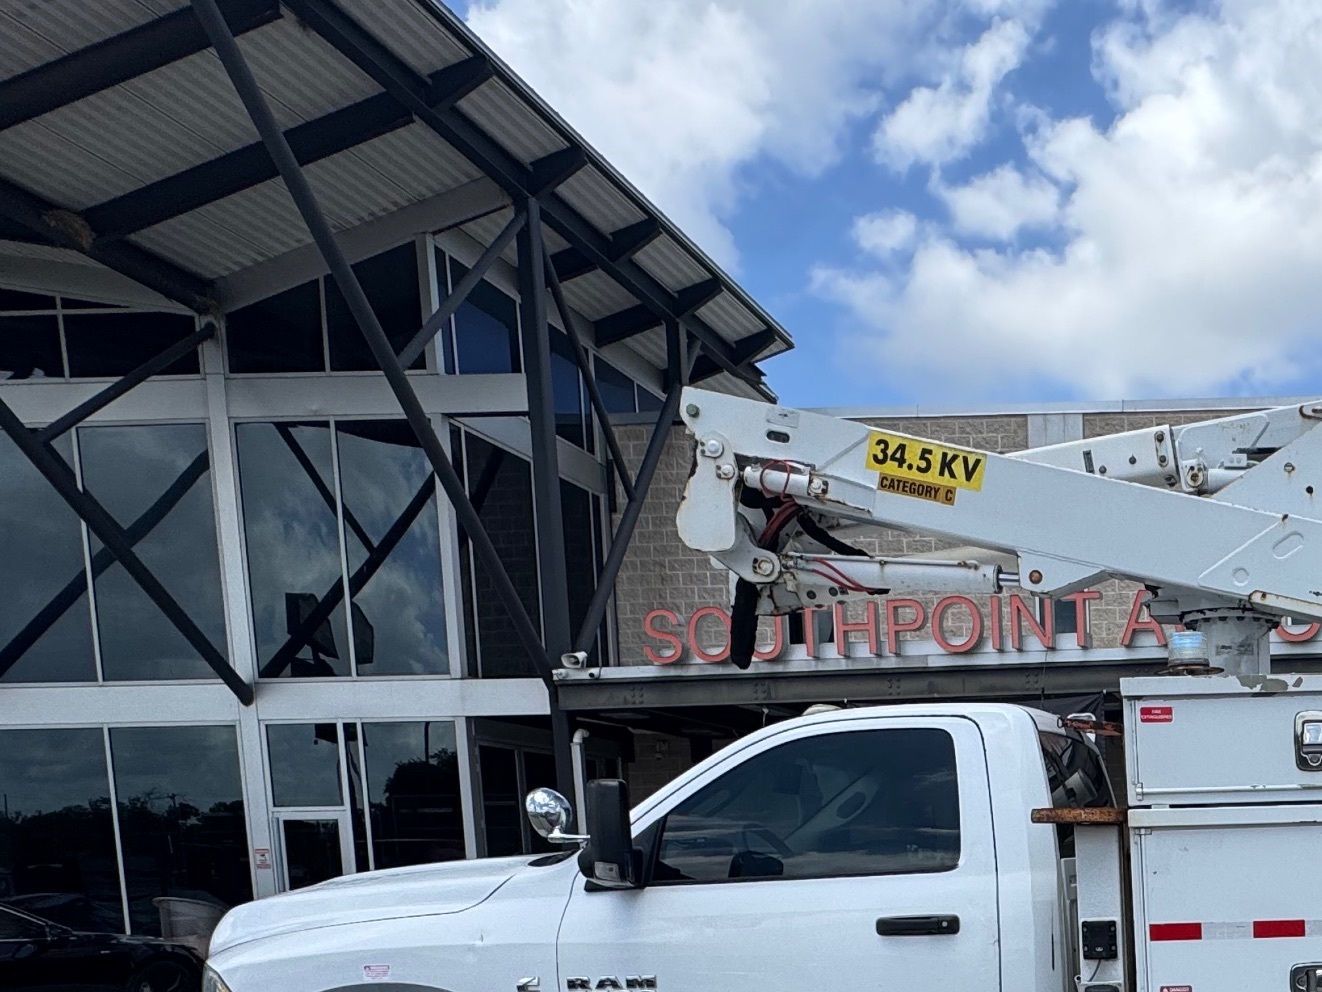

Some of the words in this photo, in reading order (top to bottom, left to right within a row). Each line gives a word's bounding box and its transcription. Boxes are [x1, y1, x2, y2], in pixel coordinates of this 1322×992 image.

[872, 438, 933, 474] 34.5
[938, 451, 982, 483] KV
[880, 476, 941, 500] CATEGORY
[944, 488, 954, 502] C
[566, 975, 658, 990] RAM
